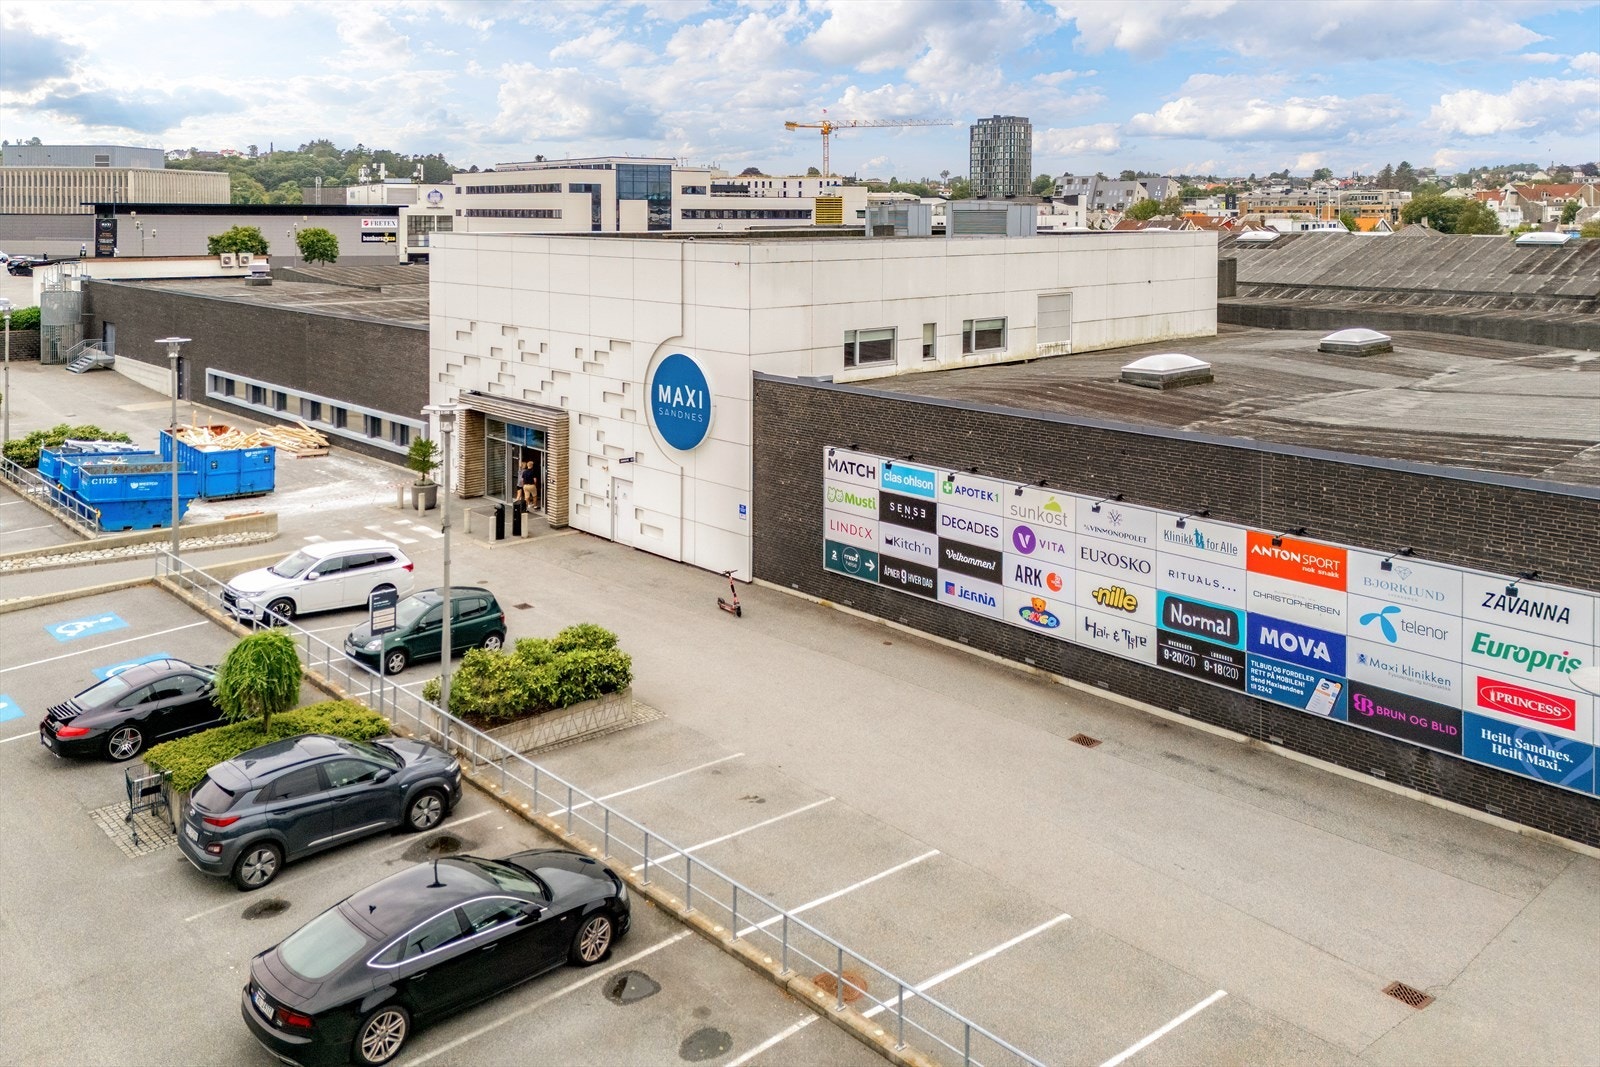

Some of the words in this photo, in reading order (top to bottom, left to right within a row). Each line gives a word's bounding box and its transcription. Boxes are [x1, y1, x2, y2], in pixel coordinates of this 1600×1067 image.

[659, 384, 703, 408] MAXI
[658, 407, 703, 423] SANDNES
[828, 458, 875, 480] MATCH
[884, 470, 902, 485] clas
[904, 475, 933, 491] ohlson
[844, 491, 876, 510] Musti
[955, 484, 993, 502] APOTEK
[995, 494, 999, 502] 1
[1011, 502, 1068, 527] sunkost
[830, 519, 872, 540] LINDEX
[942, 515, 999, 538] DECADES
[1090, 526, 1147, 543] VINMONOPOLET
[832, 550, 837, 558] 2
[1039, 541, 1065, 554] VITA
[1164, 529, 1194, 546] Klinikk
[1206, 537, 1219, 552] for
[1220, 541, 1238, 556] Alle
[946, 549, 995, 571] Velkommen!
[1081, 546, 1151, 574] EUROSKO
[1251, 544, 1300, 562] ANTON
[1302, 553, 1340, 571] SPORT
[901, 570, 906, 583] 9
[908, 573, 921, 585] HVER
[922, 578, 933, 588] DAG
[1015, 564, 1042, 588] ARK
[1302, 566, 1315, 574] nok
[1317, 568, 1339, 578] snakk
[1364, 576, 1445, 603] BJØRKLUND
[1253, 590, 1340, 616] CHRISTOPHERSEN
[1482, 592, 1570, 624] ZAVANNA
[1085, 616, 1110, 638] Hair
[1171, 603, 1231, 636] Normal
[1401, 618, 1448, 640] telenor
[1260, 626, 1331, 663] MOVA
[1471, 632, 1582, 674] Europris
[1164, 649, 1196, 668] 9-20(21)
[1204, 660, 1238, 681] 9-18(20)
[1251, 660, 1272, 671] TILBUD
[1283, 669, 1314, 682] FORDELER
[1370, 658, 1398, 673] Maxi
[1402, 665, 1451, 686] klinikken
[1251, 668, 1265, 677] RETT
[1267, 671, 1275, 679] PÅ
[1276, 676, 1305, 688] MOBILEN!
[1251, 676, 1265, 684] Send
[1266, 680, 1303, 695] Maxisandnes
[1258, 685, 1272, 694] 2242
[1496, 691, 1562, 716] PRINCESS
[1376, 705, 1407, 723] BRUN
[1409, 714, 1429, 728] OG
[1431, 720, 1457, 736] BLID
[1481, 728, 1511, 747] Heilt
[1514, 736, 1573, 763] Sandnes.
[1492, 743, 1524, 763] Heilt
[1526, 752, 1562, 772] Maxi.
